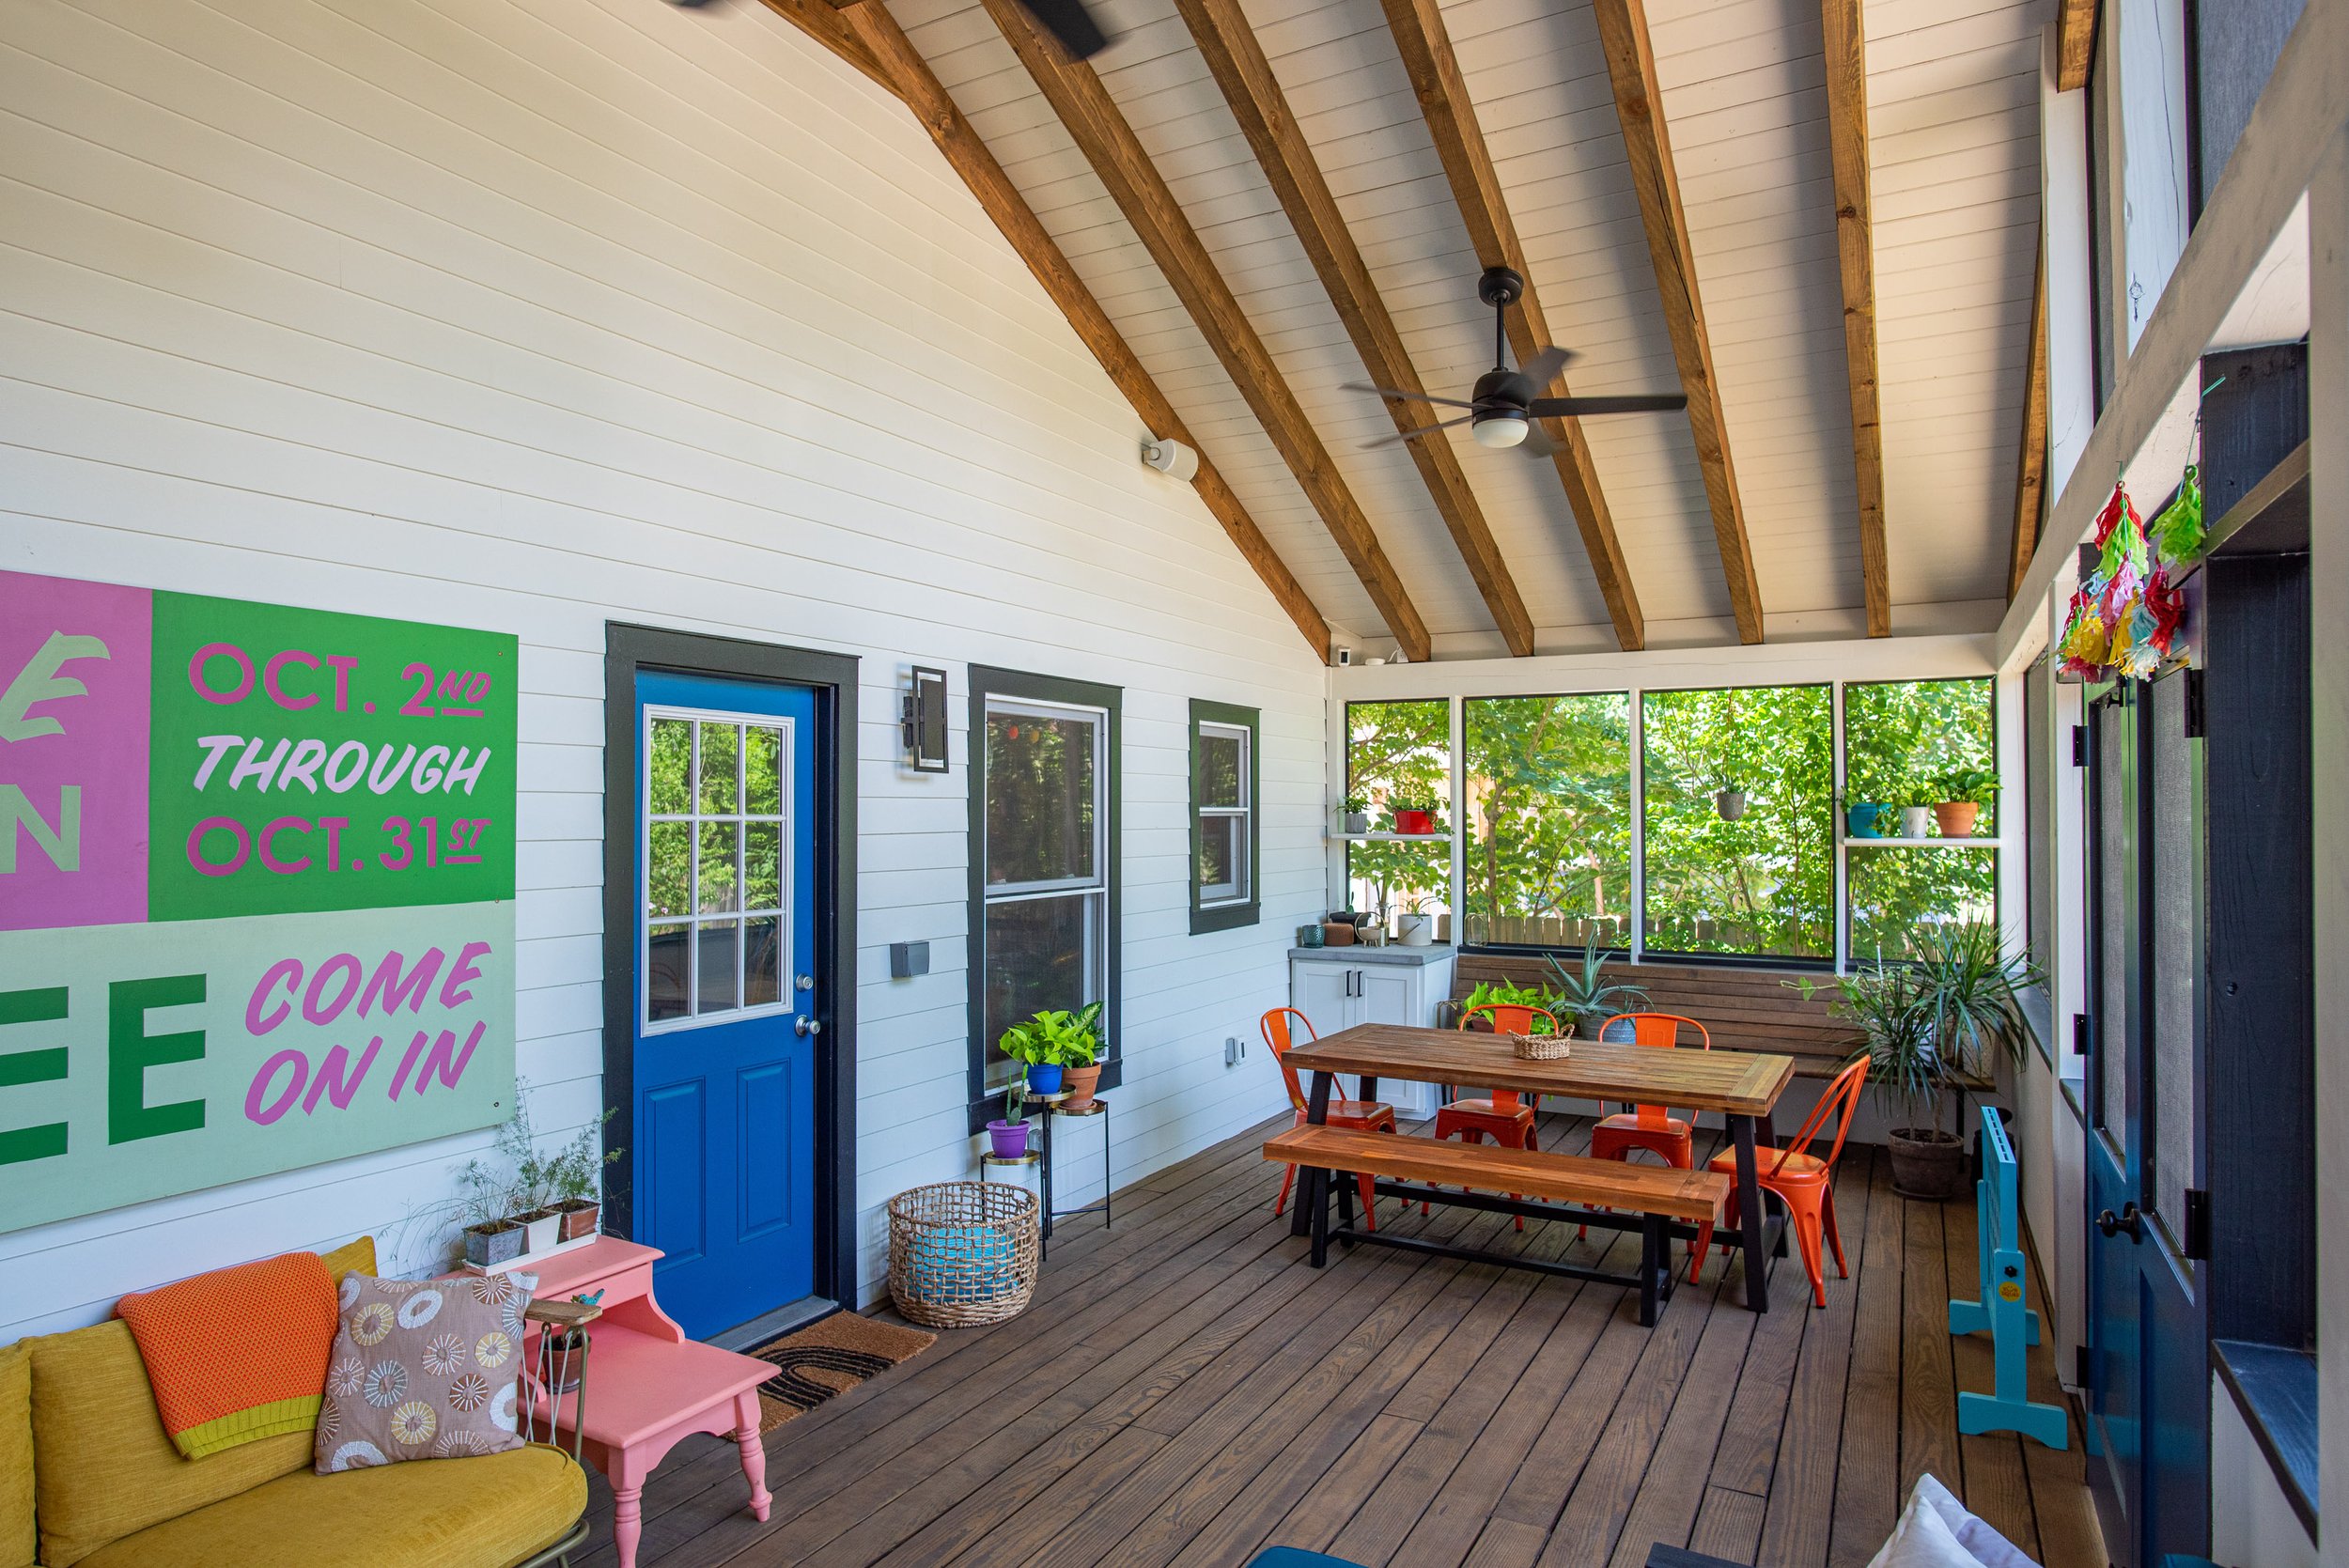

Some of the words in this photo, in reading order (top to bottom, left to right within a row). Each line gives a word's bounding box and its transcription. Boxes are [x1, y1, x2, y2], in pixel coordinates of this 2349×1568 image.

[189, 642, 377, 714] OCT.
[398, 661, 492, 718] 2ND
[194, 735, 491, 796] THROUGH
[186, 815, 365, 877] OCT.
[379, 815, 492, 872] 31ST
[245, 941, 492, 1036] COME
[244, 1035, 383, 1126] ON
[388, 1020, 487, 1102] IN
